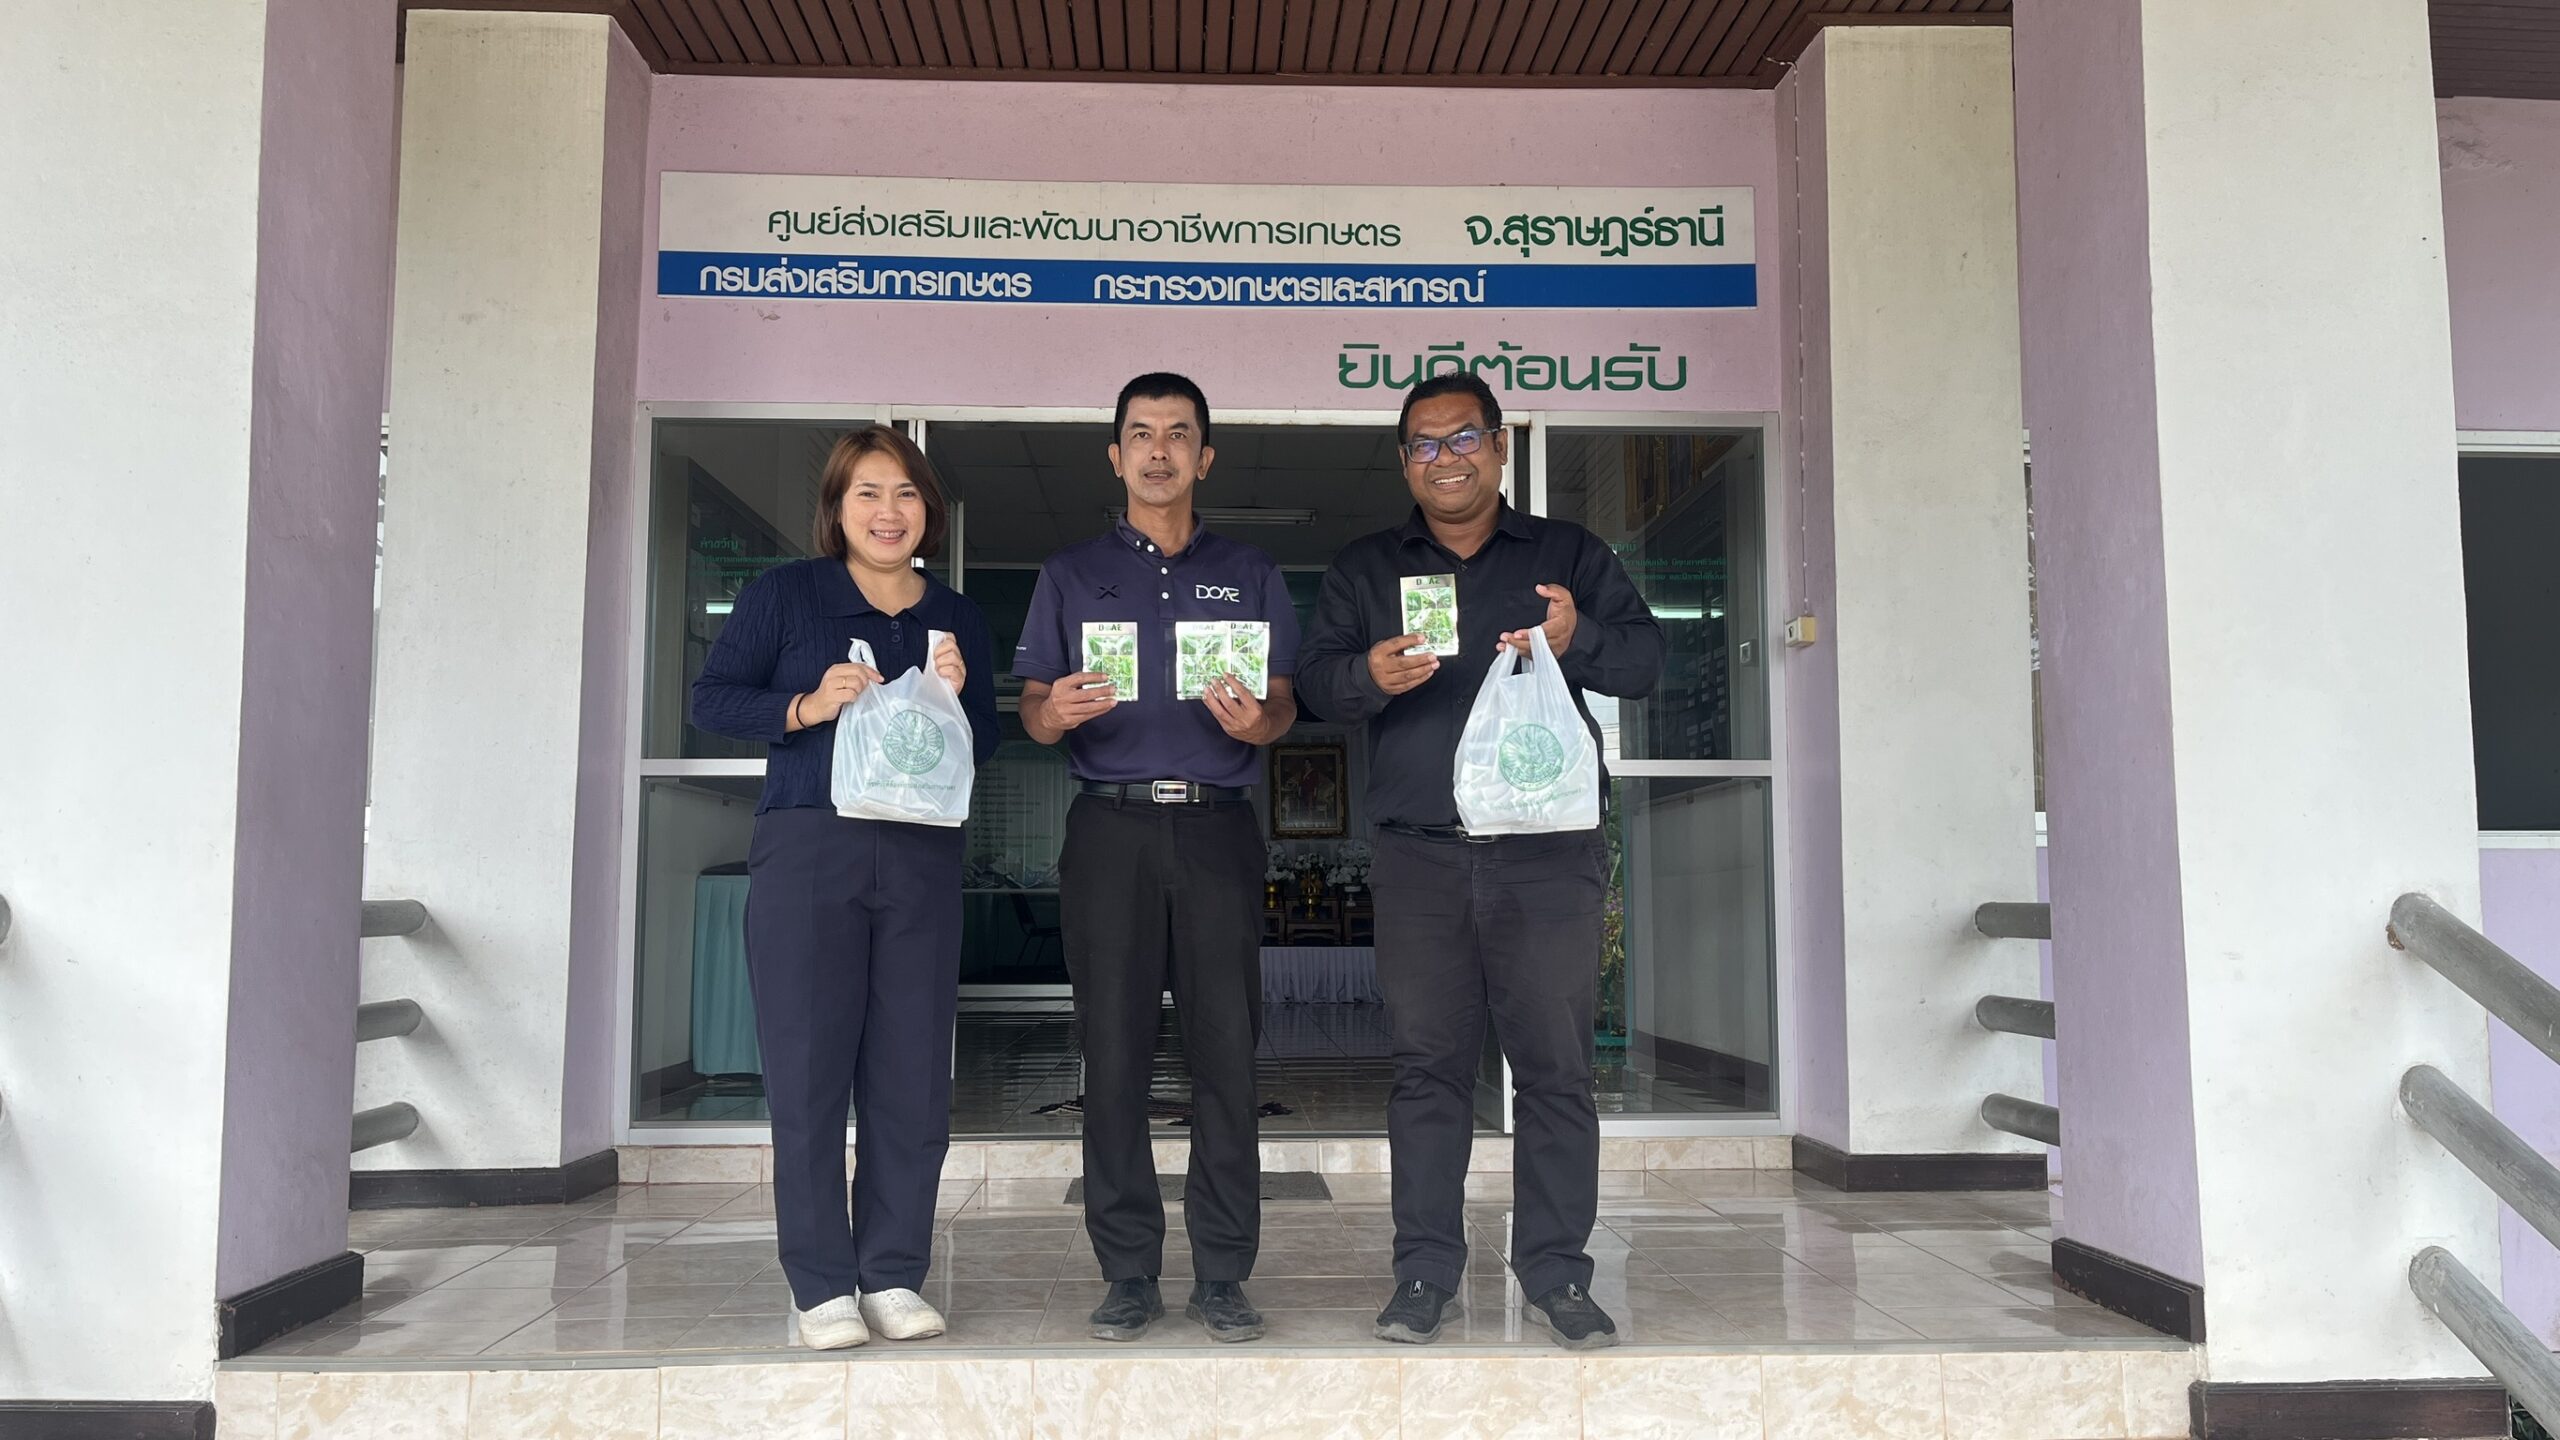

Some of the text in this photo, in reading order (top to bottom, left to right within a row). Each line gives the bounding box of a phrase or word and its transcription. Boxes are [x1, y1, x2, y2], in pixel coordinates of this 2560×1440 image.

[767, 204, 1724, 258] ศูนย์ส่งเสริมและพัฒนาอาชีพการเกษตร จ.สุราษฎร์ธานี
[699, 257, 1488, 303] กรมส่งเสริมการเกษตร กระทรวงเกษตรและสหกรณ์
